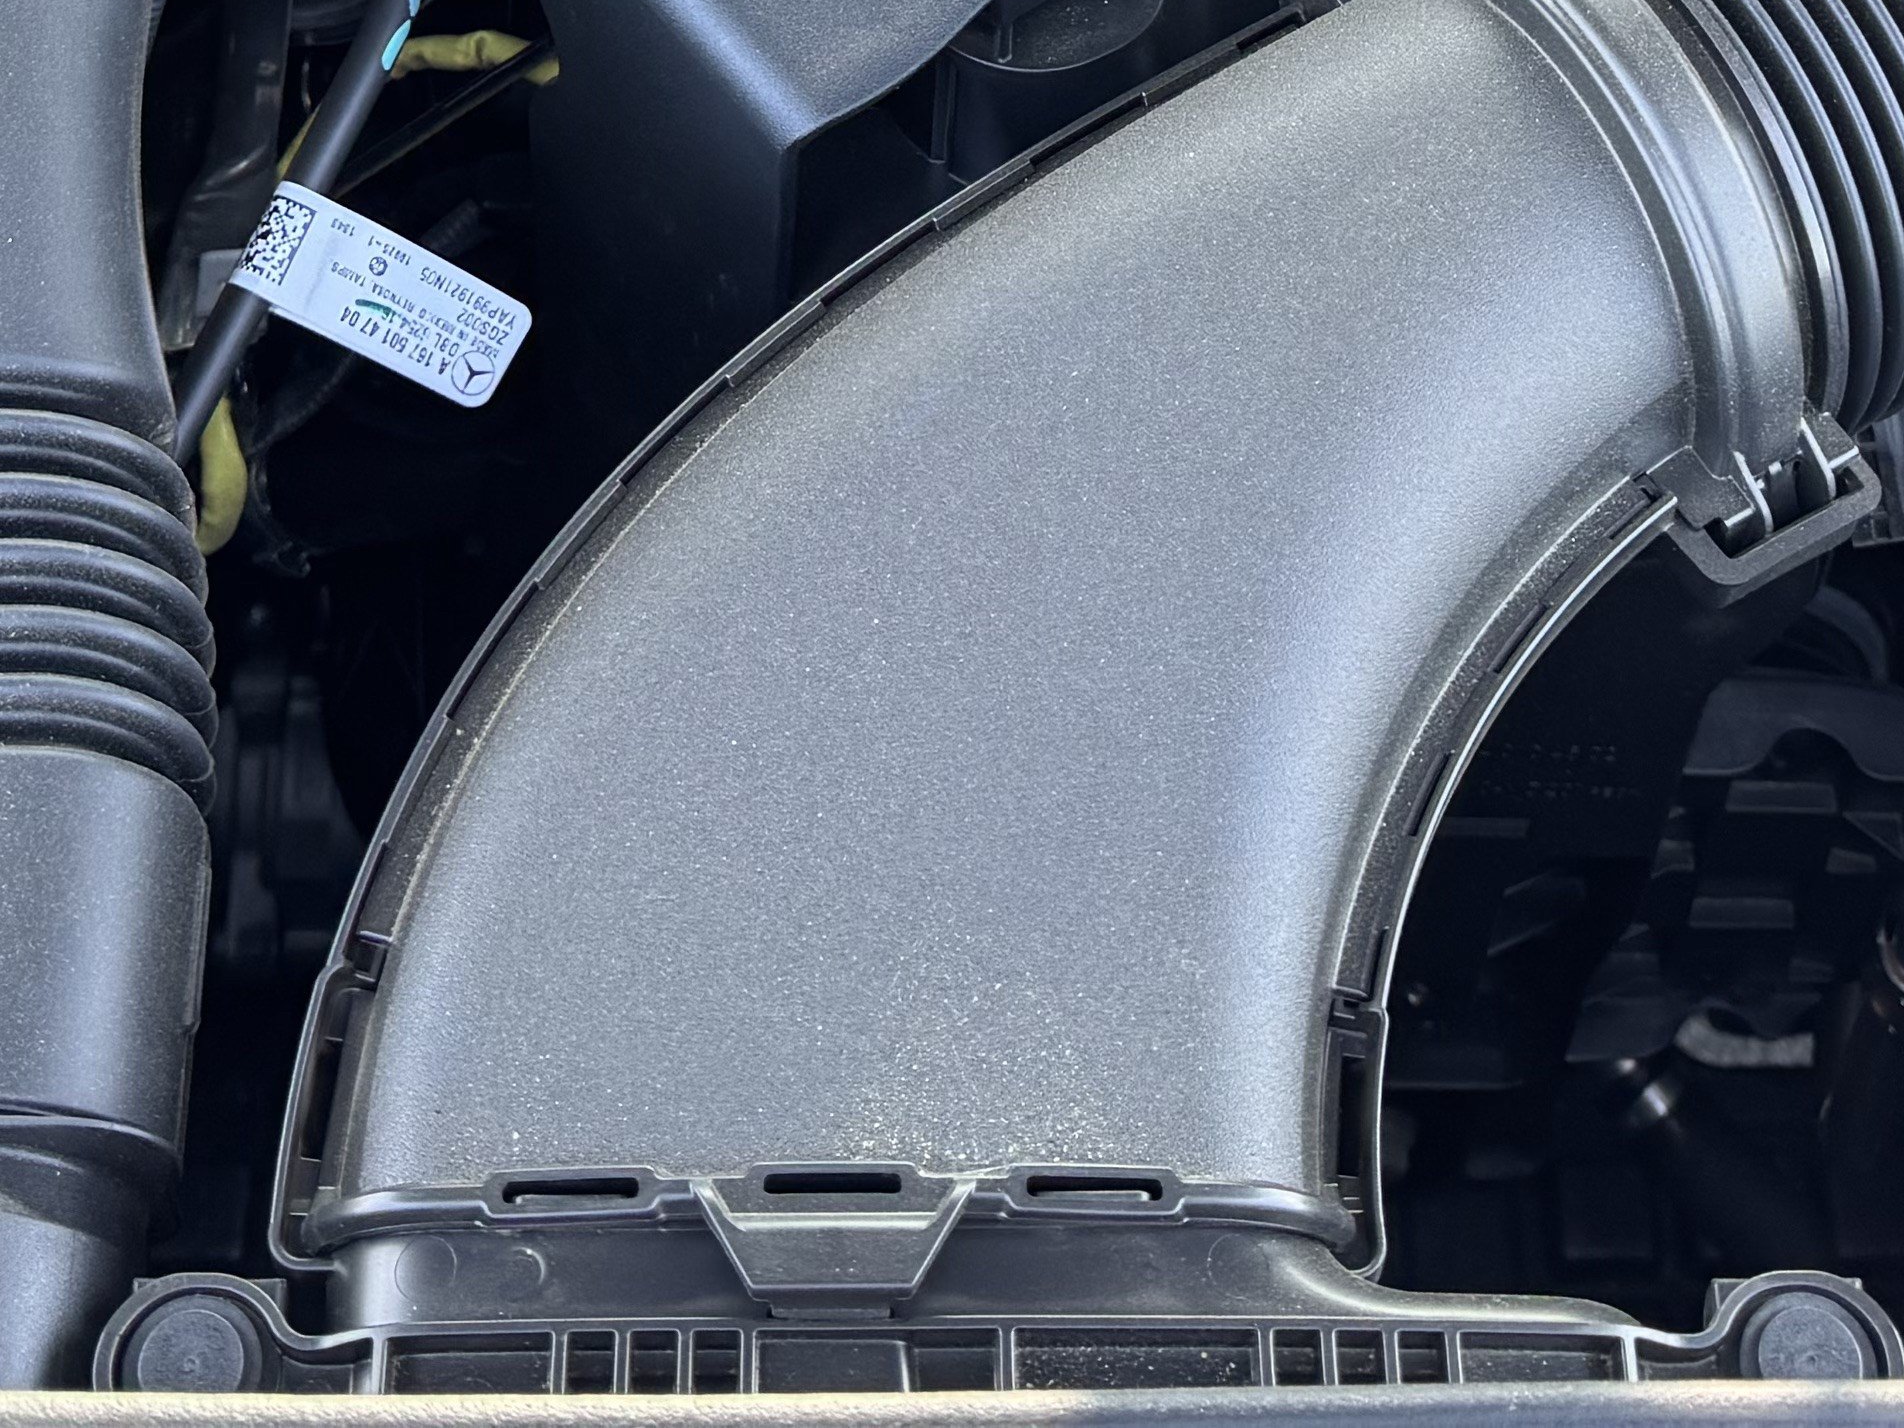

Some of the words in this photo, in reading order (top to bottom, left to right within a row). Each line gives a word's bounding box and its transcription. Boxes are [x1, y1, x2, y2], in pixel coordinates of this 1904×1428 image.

[338, 305, 361, 327] 04
[360, 316, 380, 337] 47
[407, 341, 435, 367] 167
[436, 356, 450, 375] A
